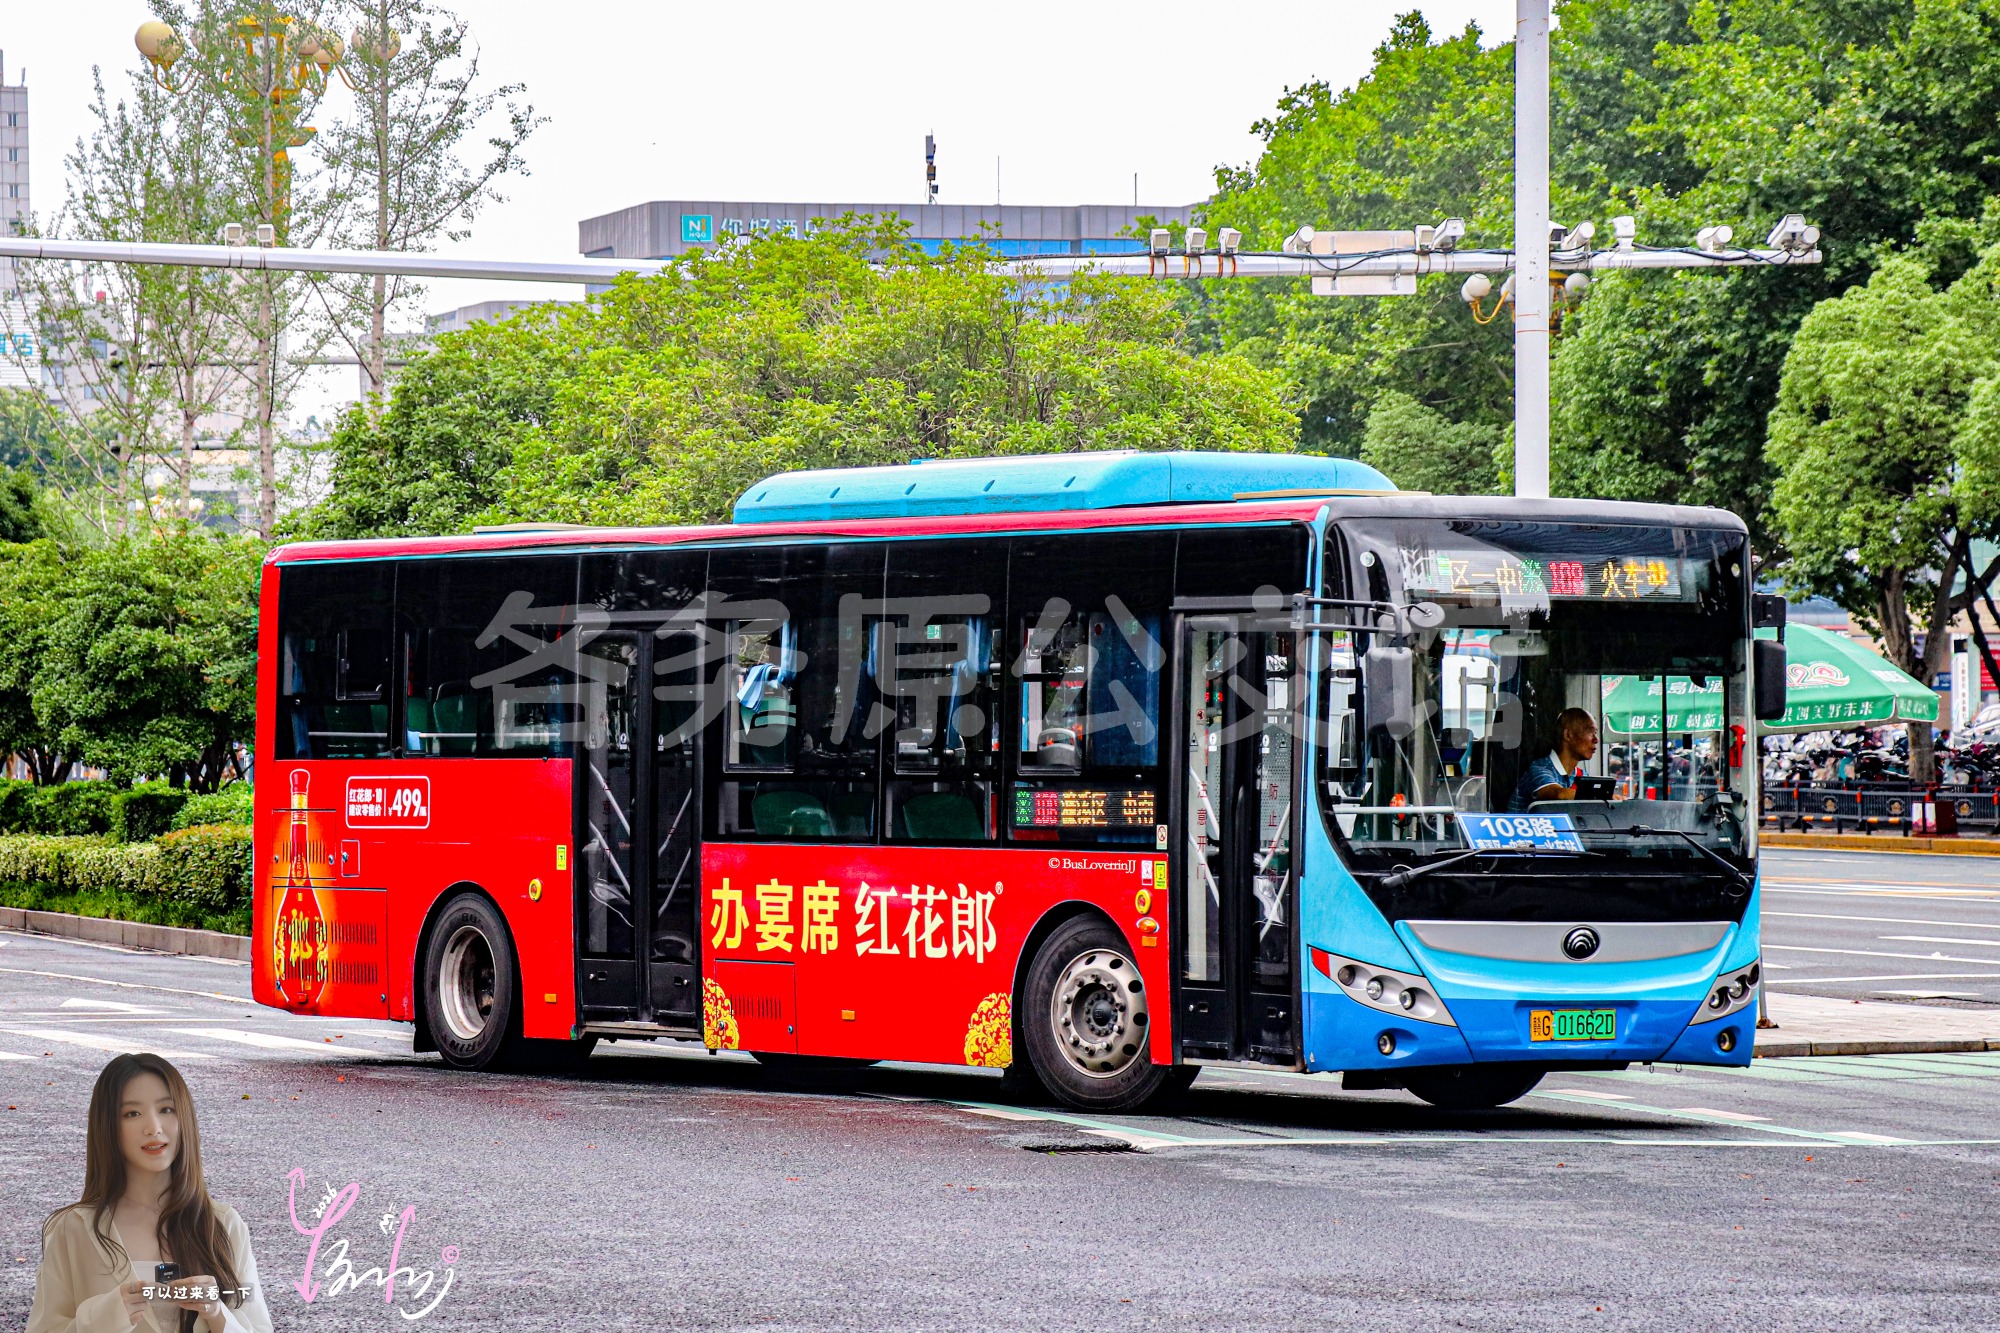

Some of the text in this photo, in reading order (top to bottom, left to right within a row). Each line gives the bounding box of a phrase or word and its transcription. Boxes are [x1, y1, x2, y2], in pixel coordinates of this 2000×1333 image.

[1549, 561, 1584, 594] 108
[1602, 560, 1669, 598] 火车站
[348, 804, 382, 816] 建议零售价
[1197, 780, 1207, 880] 注意开门
[1480, 818, 1558, 838] 108路
[711, 878, 997, 964] 办宴席 红花郎
[1558, 1013, 1614, 1035] 01662D
